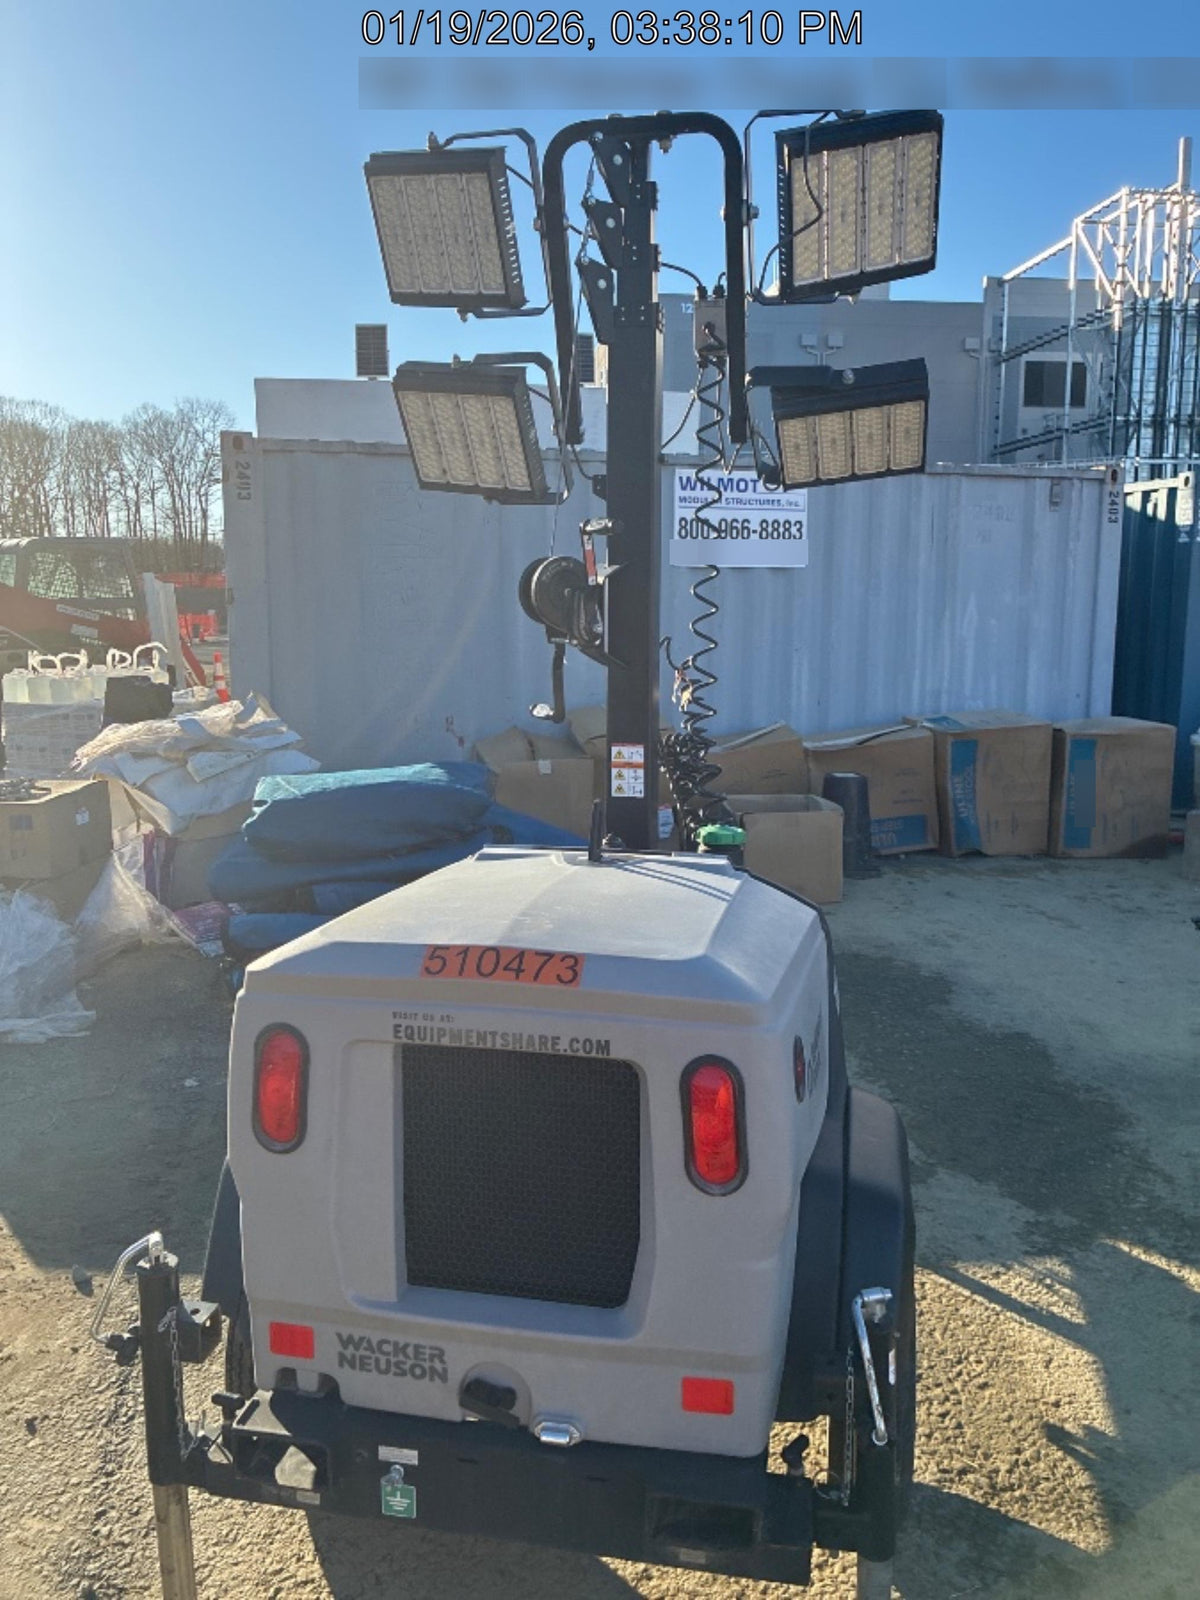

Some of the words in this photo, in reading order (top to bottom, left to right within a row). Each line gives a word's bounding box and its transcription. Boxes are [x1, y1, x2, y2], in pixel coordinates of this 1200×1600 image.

[678, 495, 723, 505] MODUL
[678, 517, 803, 540] 800966-8883
[424, 946, 579, 985] 510473
[392, 1011, 418, 1021] VISIT
[422, 1012, 435, 1022] US
[392, 1023, 611, 1056] EQUIPMENTSHARE.COM
[335, 1332, 447, 1365] WACKER
[338, 1352, 449, 1384] NEUSON
